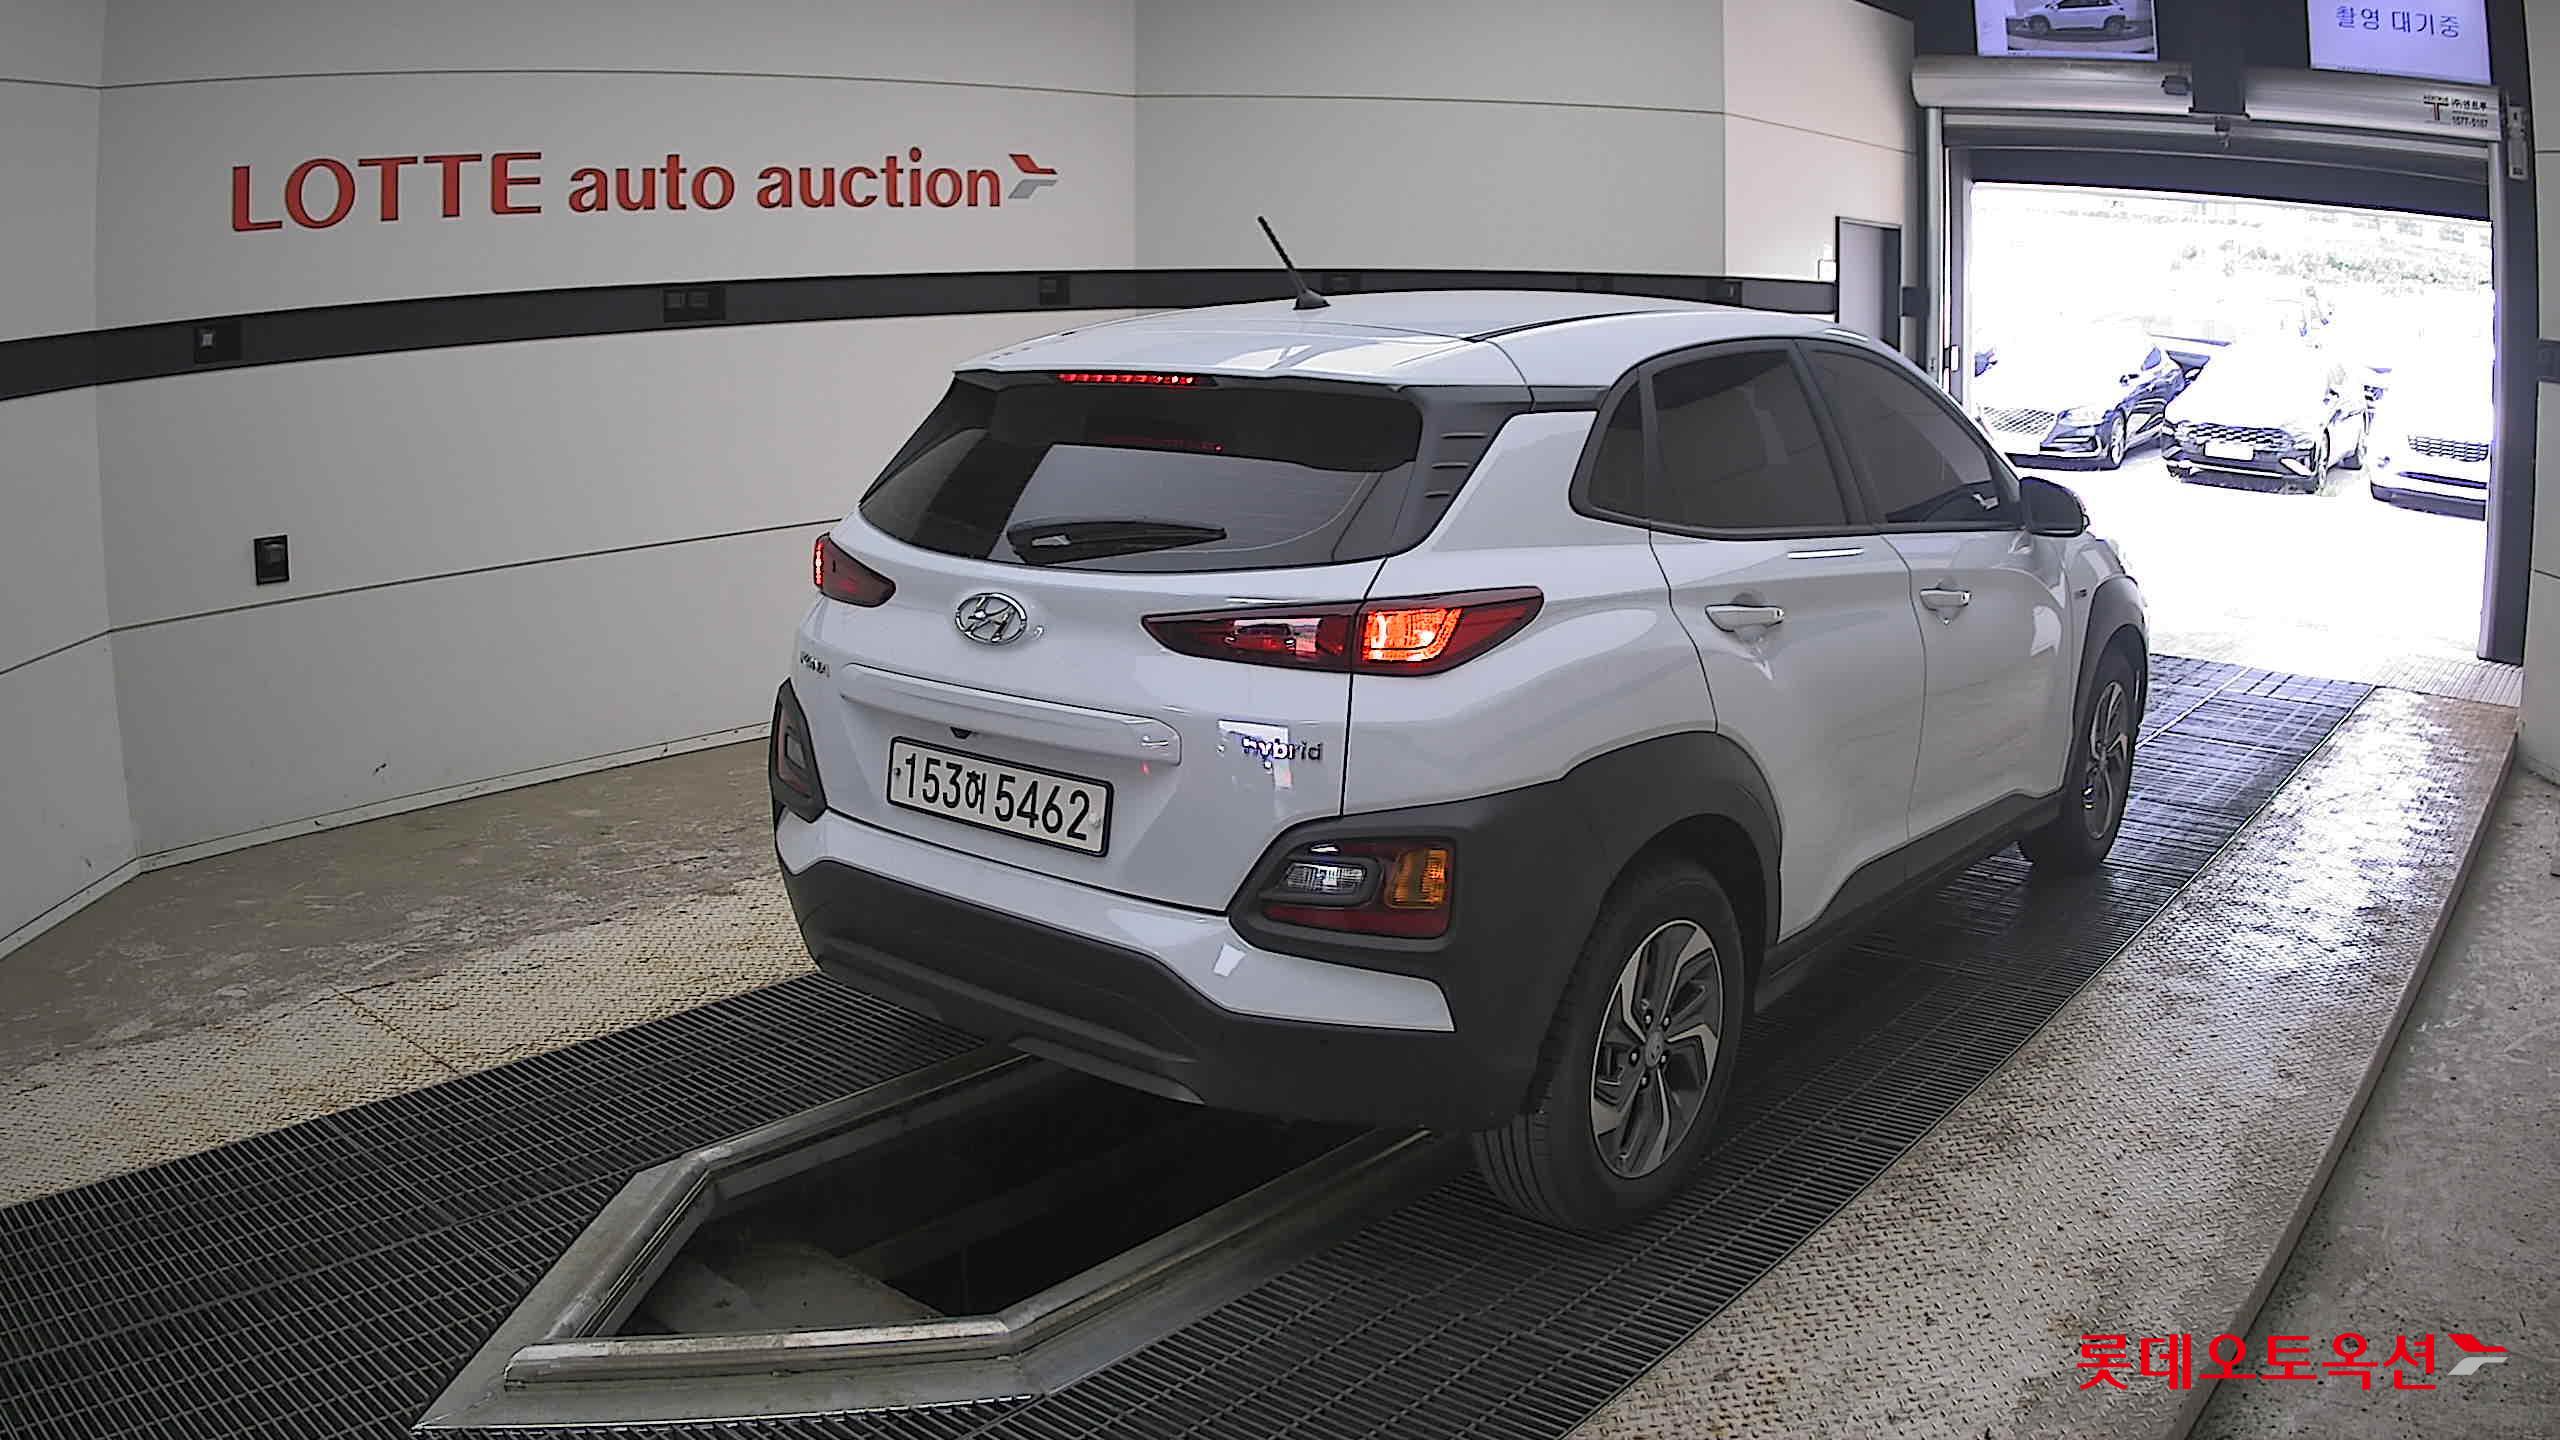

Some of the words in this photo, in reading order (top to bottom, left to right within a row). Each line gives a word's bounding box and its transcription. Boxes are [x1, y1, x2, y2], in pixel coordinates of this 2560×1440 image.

[2336, 5, 2380, 31] 촬영
[2391, 11, 2460, 39] 대기중
[231, 151, 543, 232] LOTTE
[568, 153, 737, 214] auto
[756, 147, 1002, 210] auction
